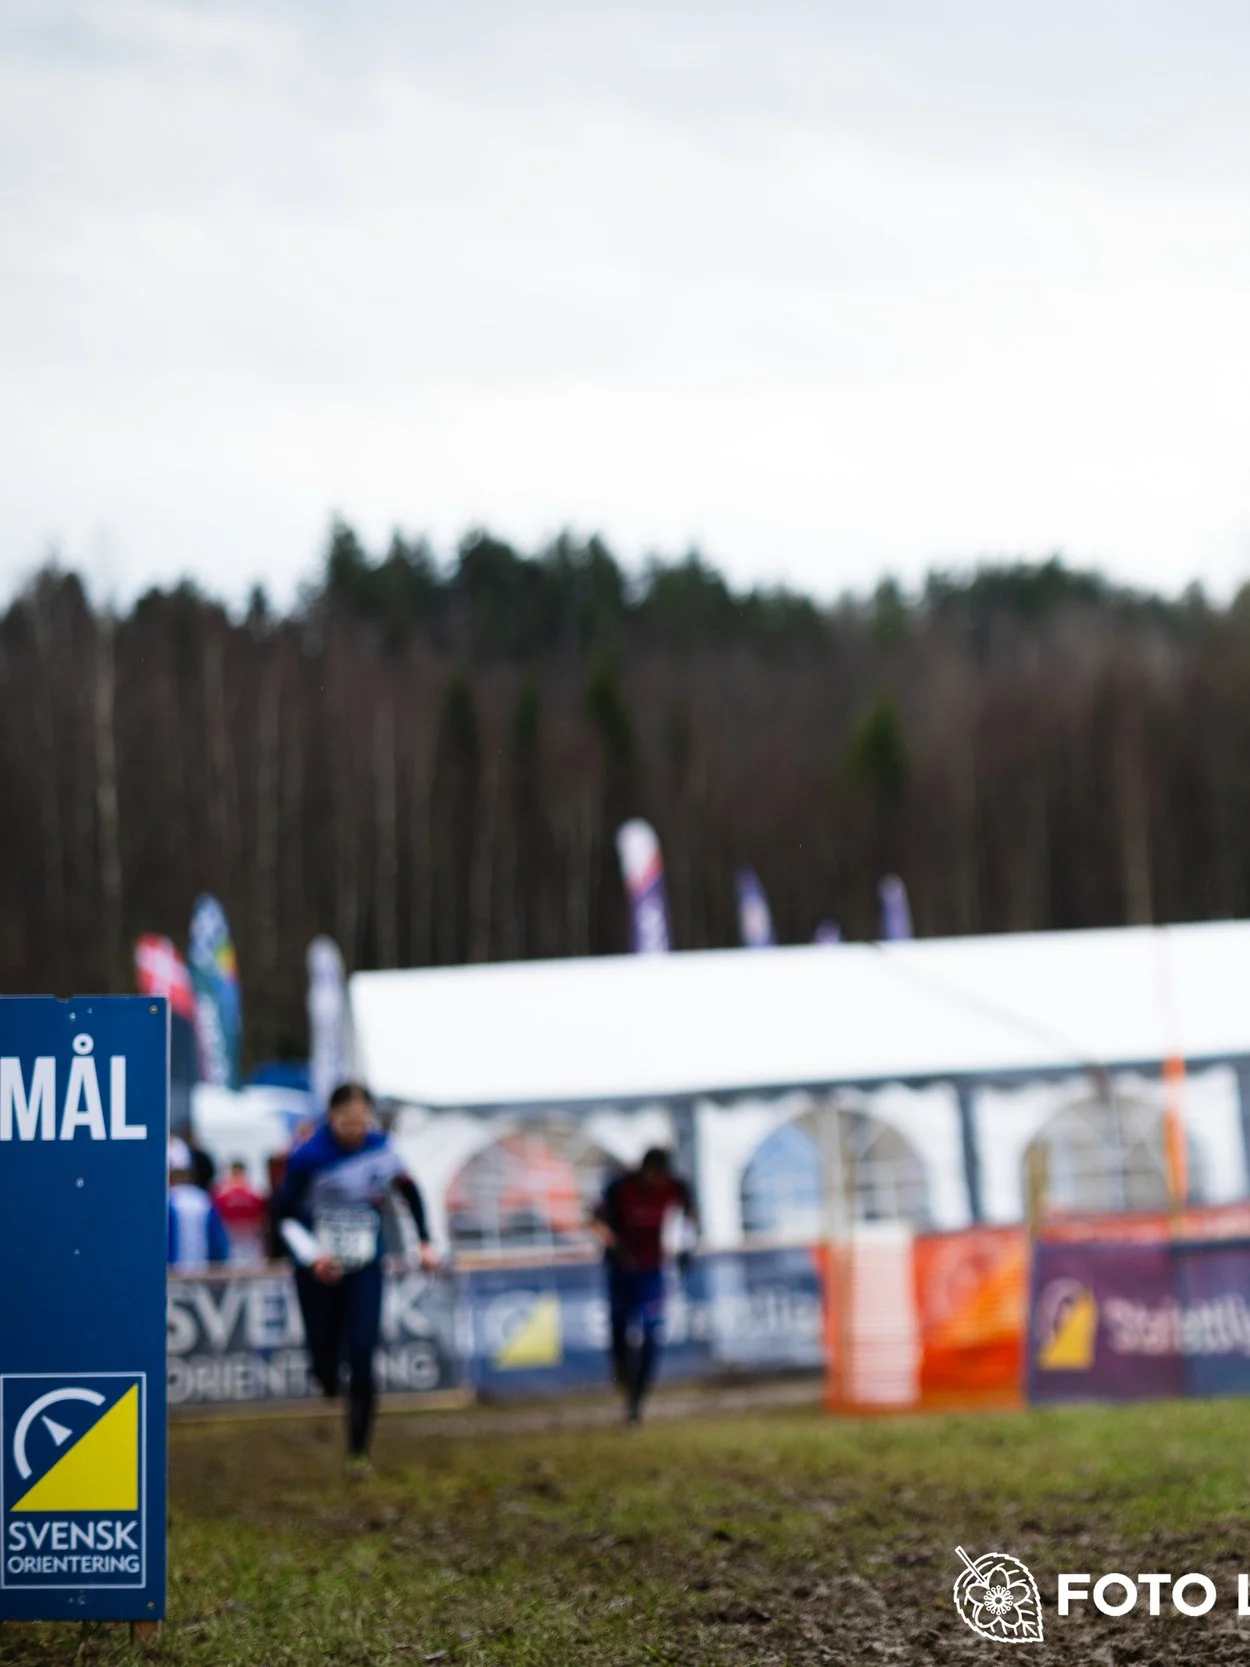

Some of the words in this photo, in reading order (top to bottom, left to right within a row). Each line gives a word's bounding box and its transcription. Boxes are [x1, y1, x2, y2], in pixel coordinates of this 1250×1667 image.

[0, 1033, 148, 1141] MÅL
[8, 1520, 139, 1551] SVENSK
[7, 1555, 140, 1574] ORIENTERING
